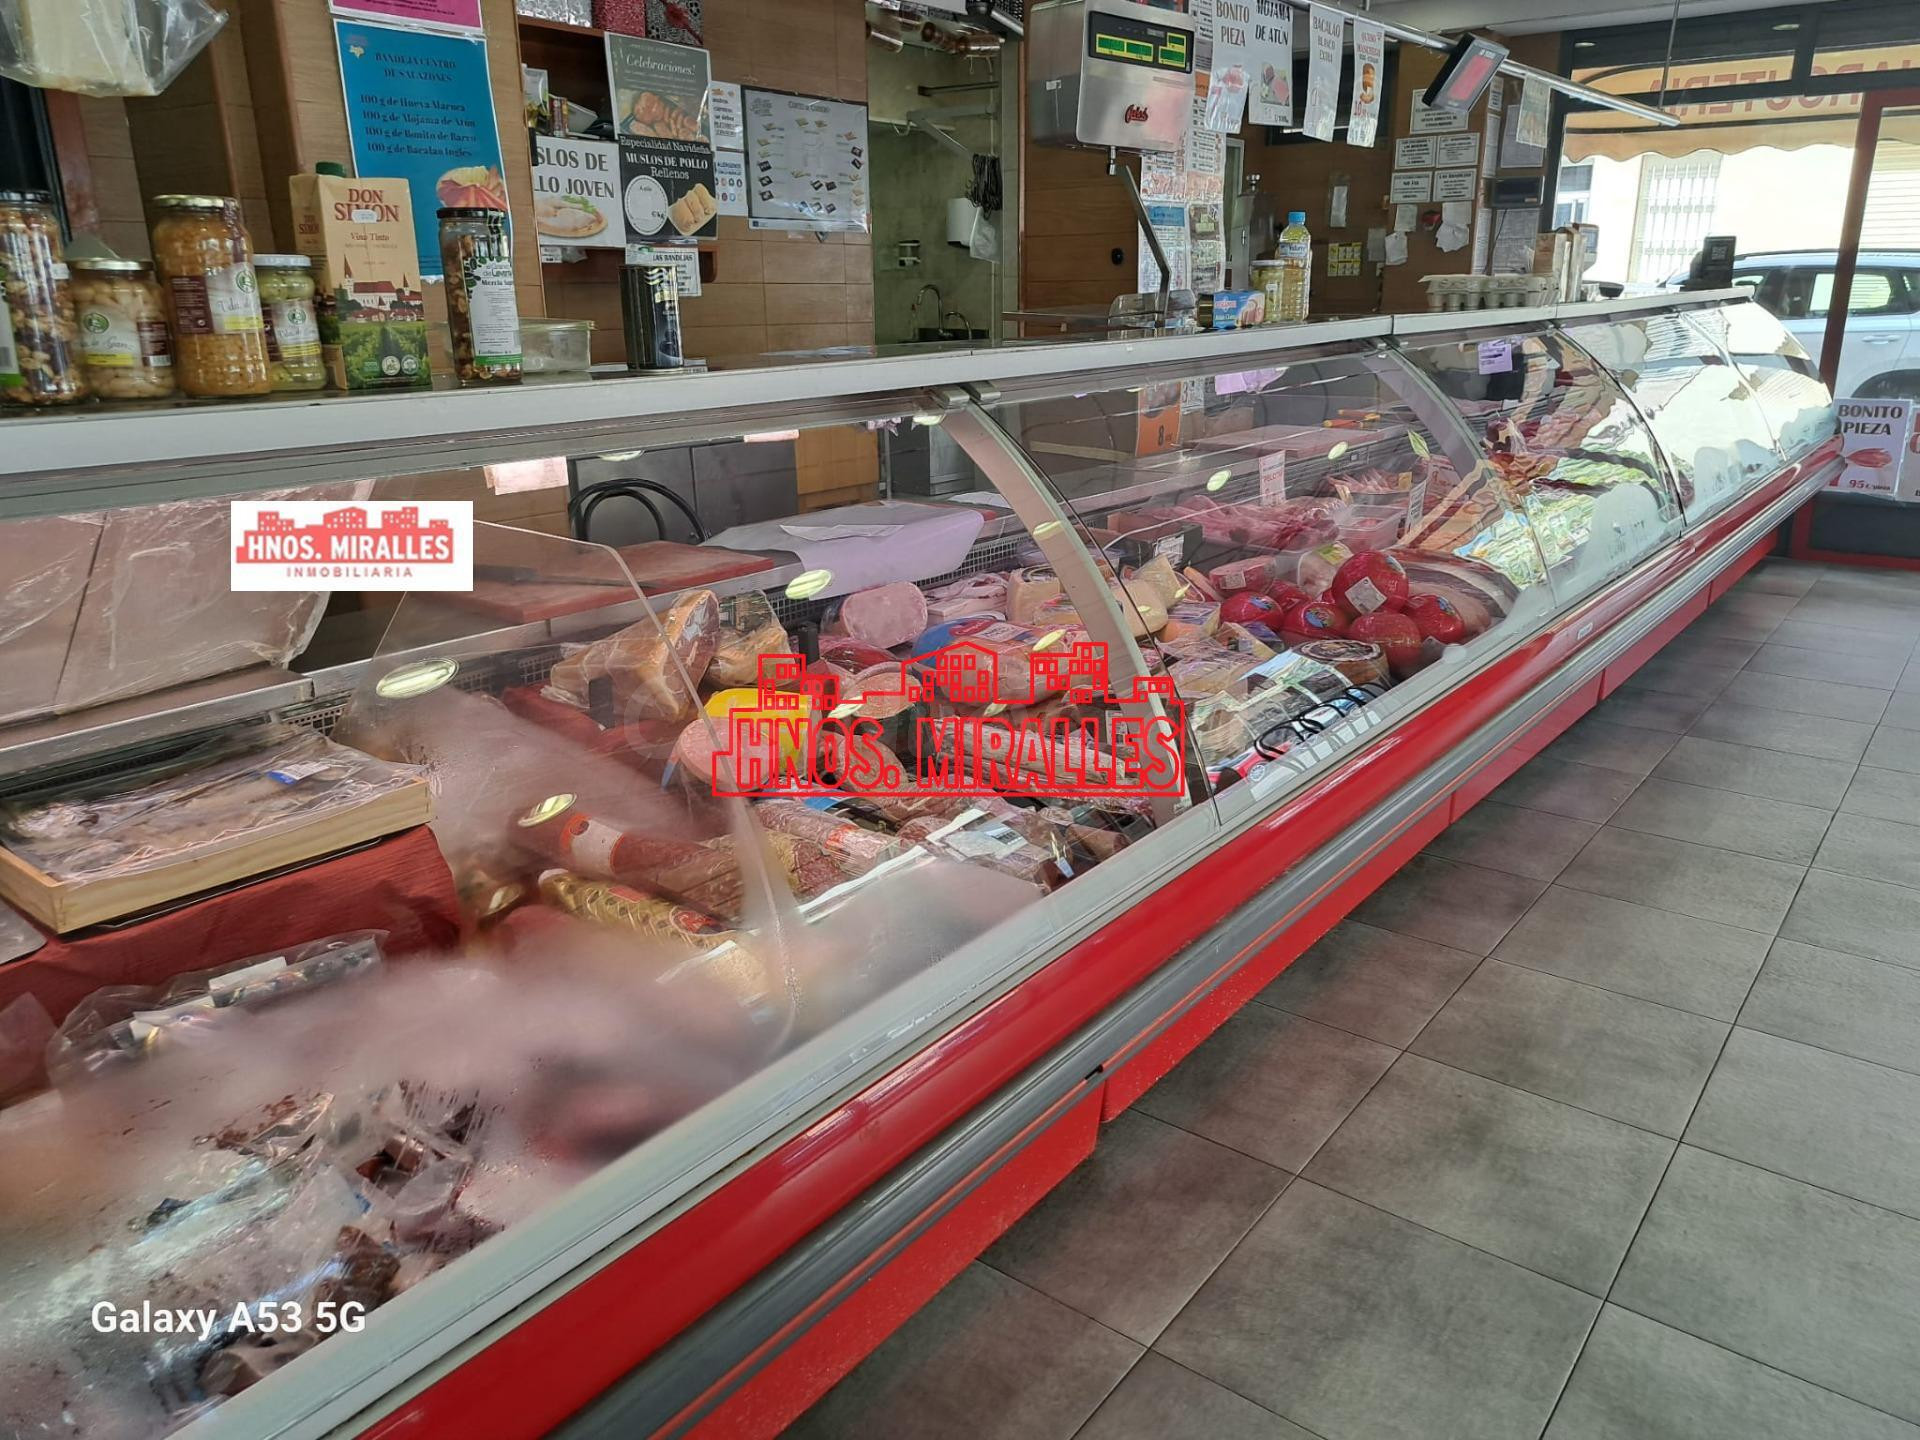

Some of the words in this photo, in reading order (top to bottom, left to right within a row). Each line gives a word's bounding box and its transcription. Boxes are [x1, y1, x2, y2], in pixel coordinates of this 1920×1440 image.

[1216, 1, 1250, 24] BONITO
[1256, 0, 1291, 22] MOJAMA
[1221, 26, 1246, 47] PIEZA
[1256, 25, 1268, 40] DE
[361, 94, 378, 104] 100
[387, 96, 397, 106] de
[362, 110, 380, 120] 100
[389, 112, 400, 121] de
[365, 126, 383, 136] 100
[392, 127, 402, 137] de
[367, 142, 385, 152] 100
[585, 152, 609, 172] DE
[625, 152, 663, 166] MUSLOS
[663, 156, 678, 167] DE
[679, 157, 708, 170] POLLO
[650, 166, 690, 180] Rellenos
[347, 188, 383, 203] DON
[565, 178, 615, 199] JOVEN
[1838, 404, 1903, 419] BONITO
[1843, 421, 1891, 436] PIEZA
